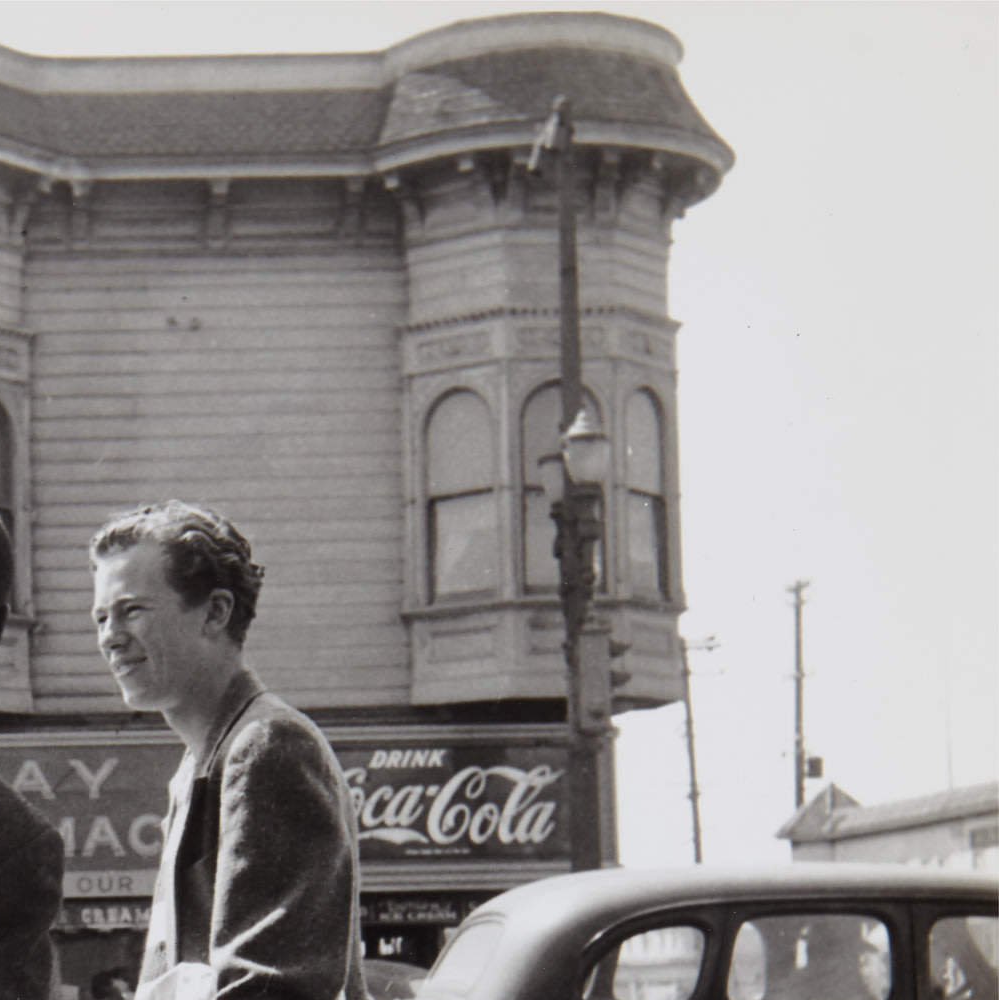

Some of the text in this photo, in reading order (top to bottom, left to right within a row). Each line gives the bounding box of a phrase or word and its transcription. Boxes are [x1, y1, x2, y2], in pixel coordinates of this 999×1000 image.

[369, 749, 448, 769] DRINK
[13, 758, 121, 800] AY
[76, 876, 133, 893] OUR
